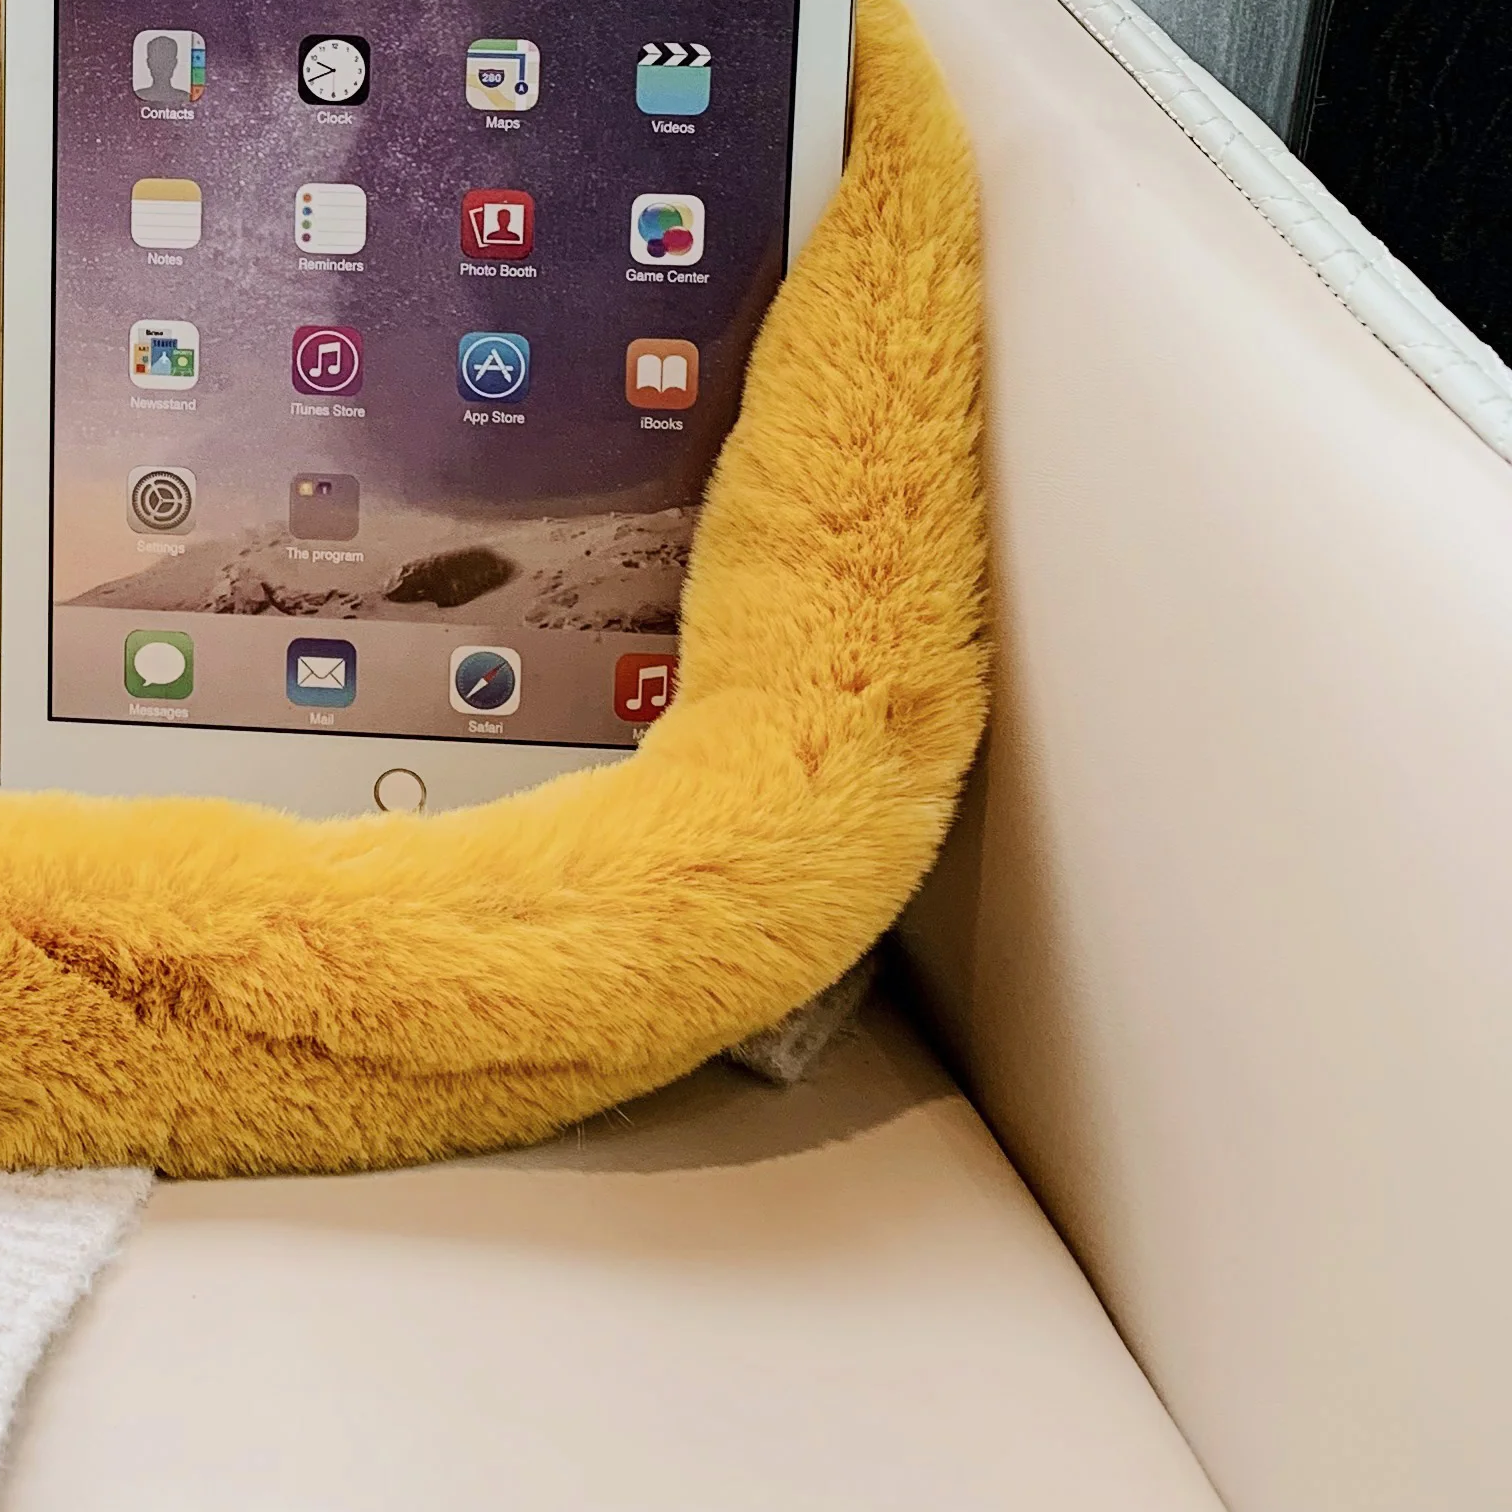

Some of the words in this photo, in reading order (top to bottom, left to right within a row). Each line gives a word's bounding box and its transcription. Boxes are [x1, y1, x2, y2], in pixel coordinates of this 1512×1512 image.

[481, 73, 502, 83] 280
[140, 106, 195, 121] Contacts
[317, 110, 353, 124] Clock
[486, 116, 521, 131] Maps
[651, 120, 695, 134] Videos
[147, 252, 183, 266] Notes
[298, 257, 364, 272] Reminders
[460, 263, 497, 277] Photo
[500, 265, 537, 278] Booth
[625, 268, 664, 283] Game
[667, 270, 710, 284] Center
[130, 396, 197, 411] Newsstand
[290, 402, 330, 416] iTunes
[332, 404, 366, 418] Store
[463, 409, 489, 425] App
[491, 410, 525, 424] Store
[640, 416, 684, 431] iBooks
[137, 540, 185, 556] Settings
[287, 547, 309, 560] The
[312, 549, 364, 564] program
[129, 703, 189, 720] Messages
[309, 712, 335, 726] Mail
[468, 720, 504, 734] Safari
